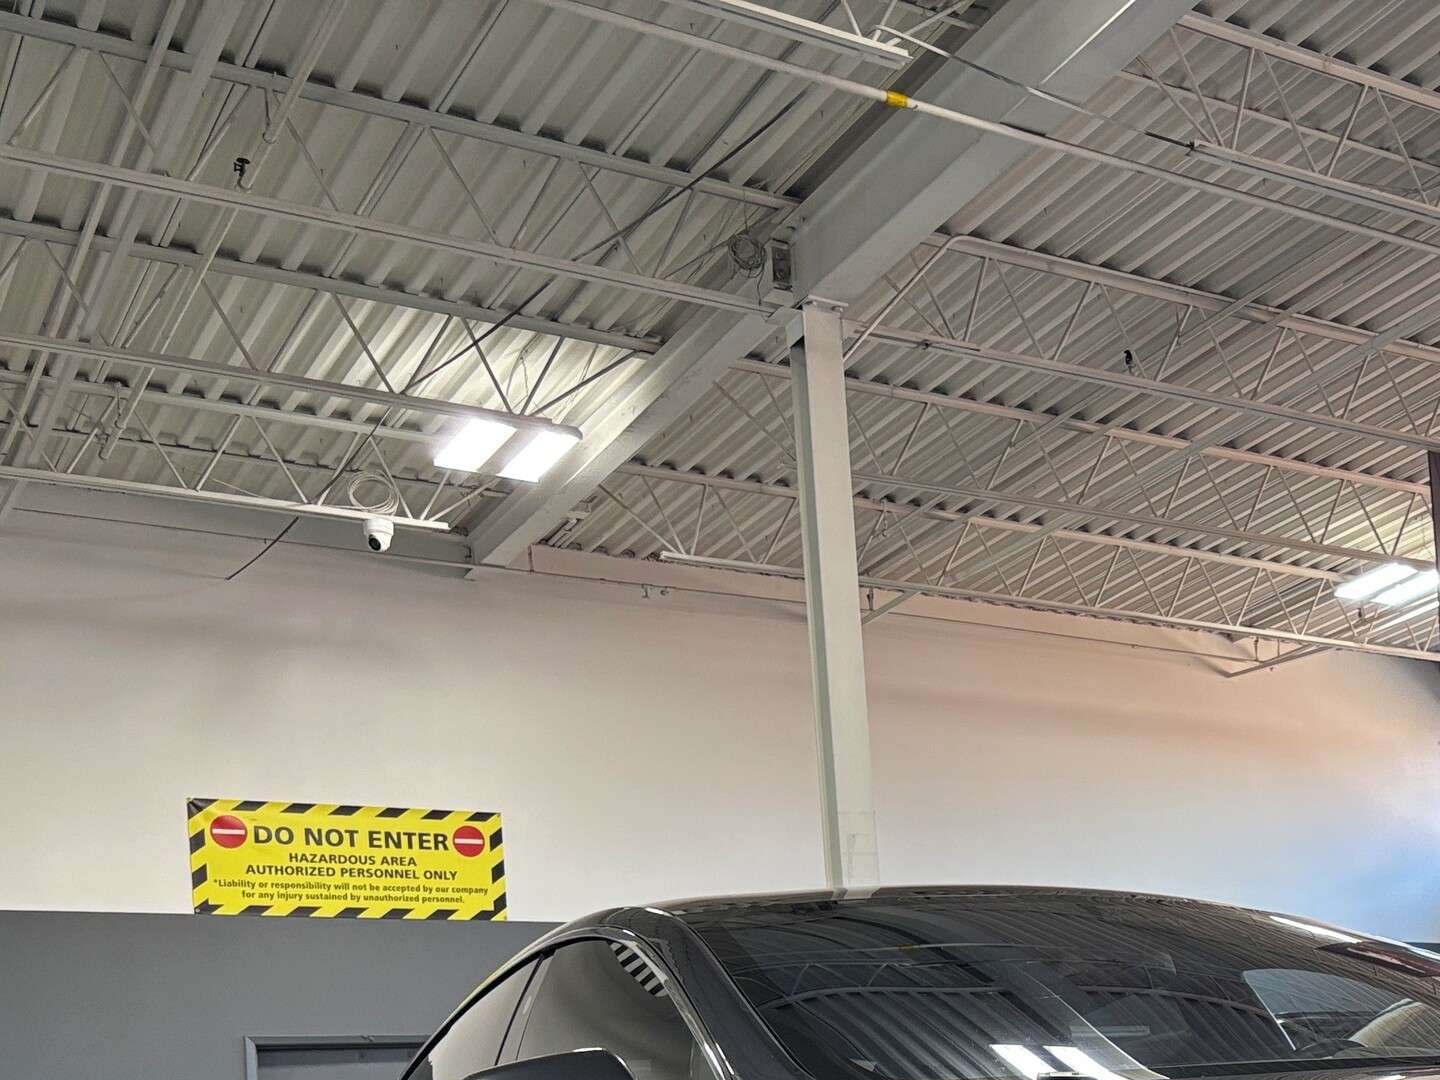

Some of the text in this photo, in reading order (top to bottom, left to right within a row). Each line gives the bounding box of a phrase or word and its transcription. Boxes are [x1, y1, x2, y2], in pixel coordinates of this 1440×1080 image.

[253, 825, 450, 852] DO NOT ENTER
[289, 852, 418, 867] HAZARDOUS AREA
[245, 864, 458, 881] AUTHORIZED PERSONNEL ONLY
[258, 880, 268, 889] or
[270, 880, 332, 892] responsibility
[334, 881, 350, 891] will
[352, 882, 367, 891] not
[369, 882, 381, 892] be
[382, 884, 421, 894] accepted
[422, 884, 434, 895] by
[435, 886, 450, 894] our
[451, 886, 489, 896] company
[241, 889, 256, 899] for
[258, 891, 275, 901] any
[277, 890, 304, 902] injury
[305, 891, 349, 901] sustained
[350, 892, 362, 903] by
[363, 894, 420, 904] unauthorized
